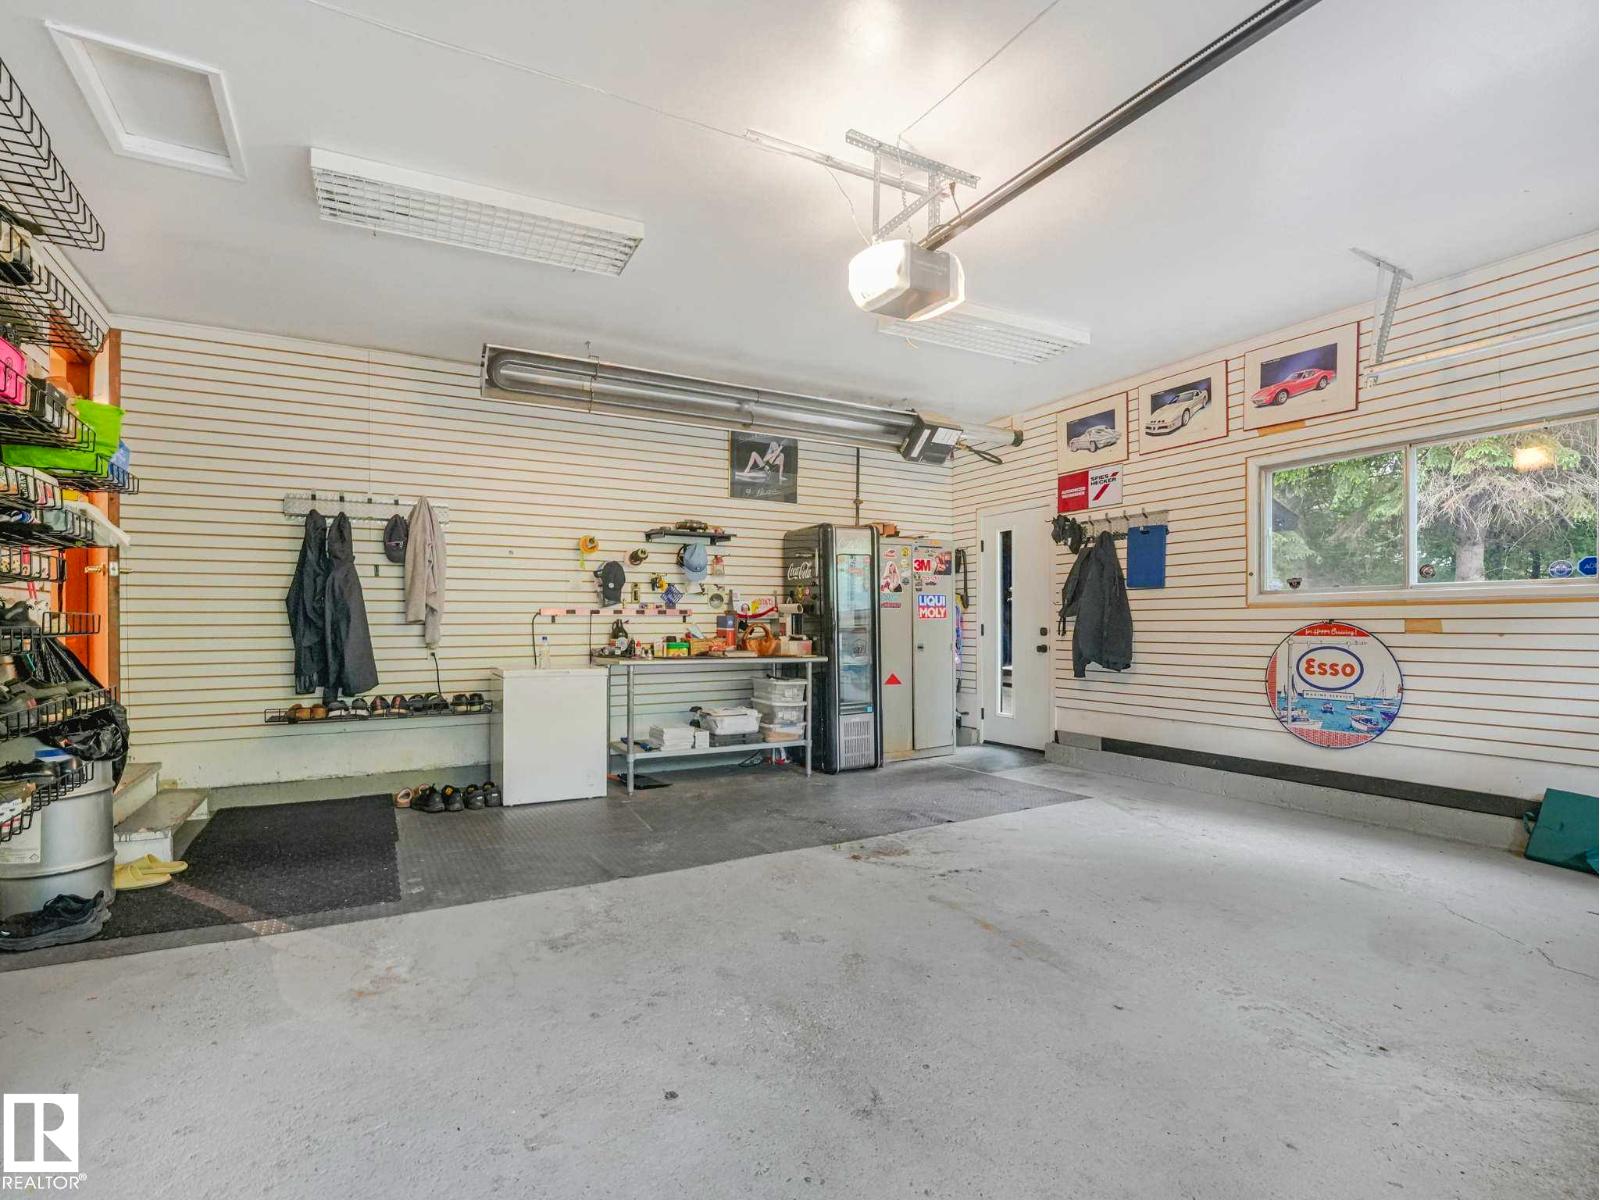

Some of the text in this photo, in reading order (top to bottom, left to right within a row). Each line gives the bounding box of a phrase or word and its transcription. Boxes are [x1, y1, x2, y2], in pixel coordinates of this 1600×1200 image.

[914, 560, 931, 571] 3M
[919, 595, 946, 606] LIQUI
[919, 607, 947, 618] MOLY
